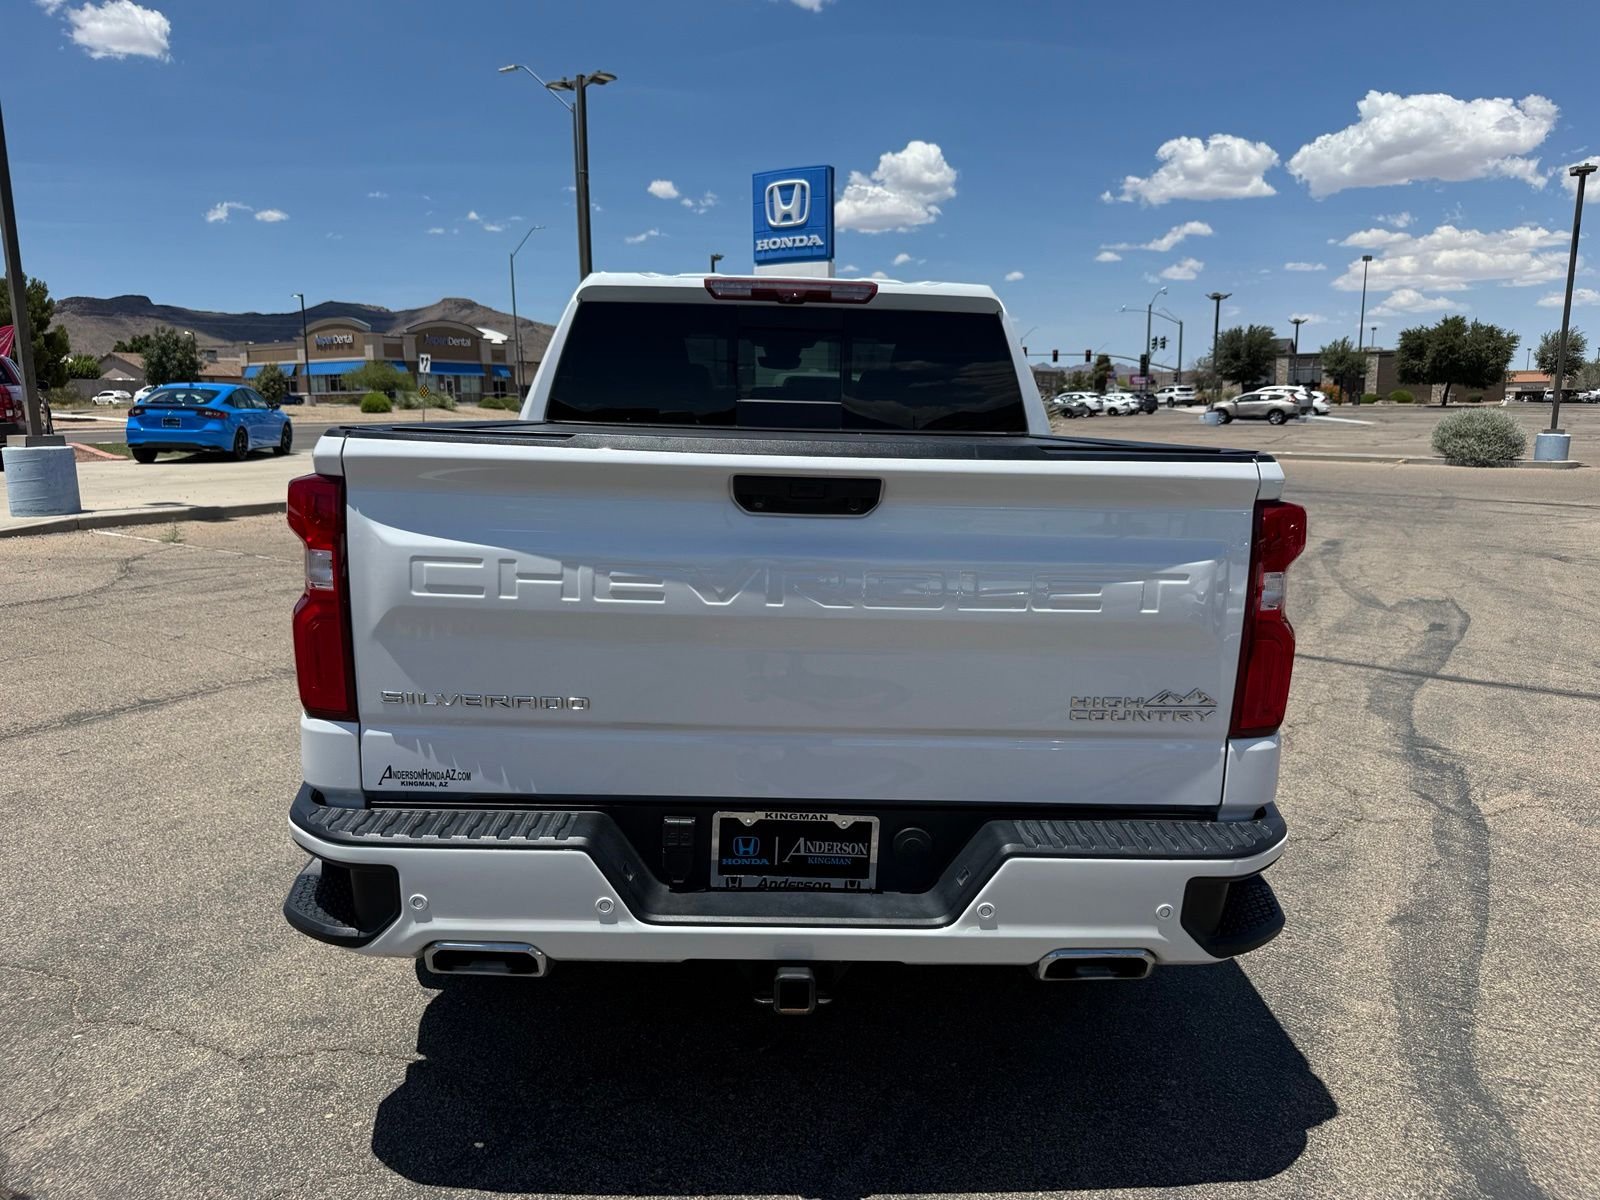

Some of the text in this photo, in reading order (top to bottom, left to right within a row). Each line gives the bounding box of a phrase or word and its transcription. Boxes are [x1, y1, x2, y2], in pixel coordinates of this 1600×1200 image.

[755, 234, 825, 251] HONDA
[410, 555, 1191, 613] CHEVROLET
[380, 690, 591, 711] SILVERADO
[1070, 696, 1145, 708] HIGH
[1069, 709, 1217, 722] COUNTRY
[401, 780, 437, 788] KINGMAN,
[764, 812, 829, 821] KINGMAN
[807, 857, 852, 865] KINGMAN
[755, 877, 832, 889] Anderson
